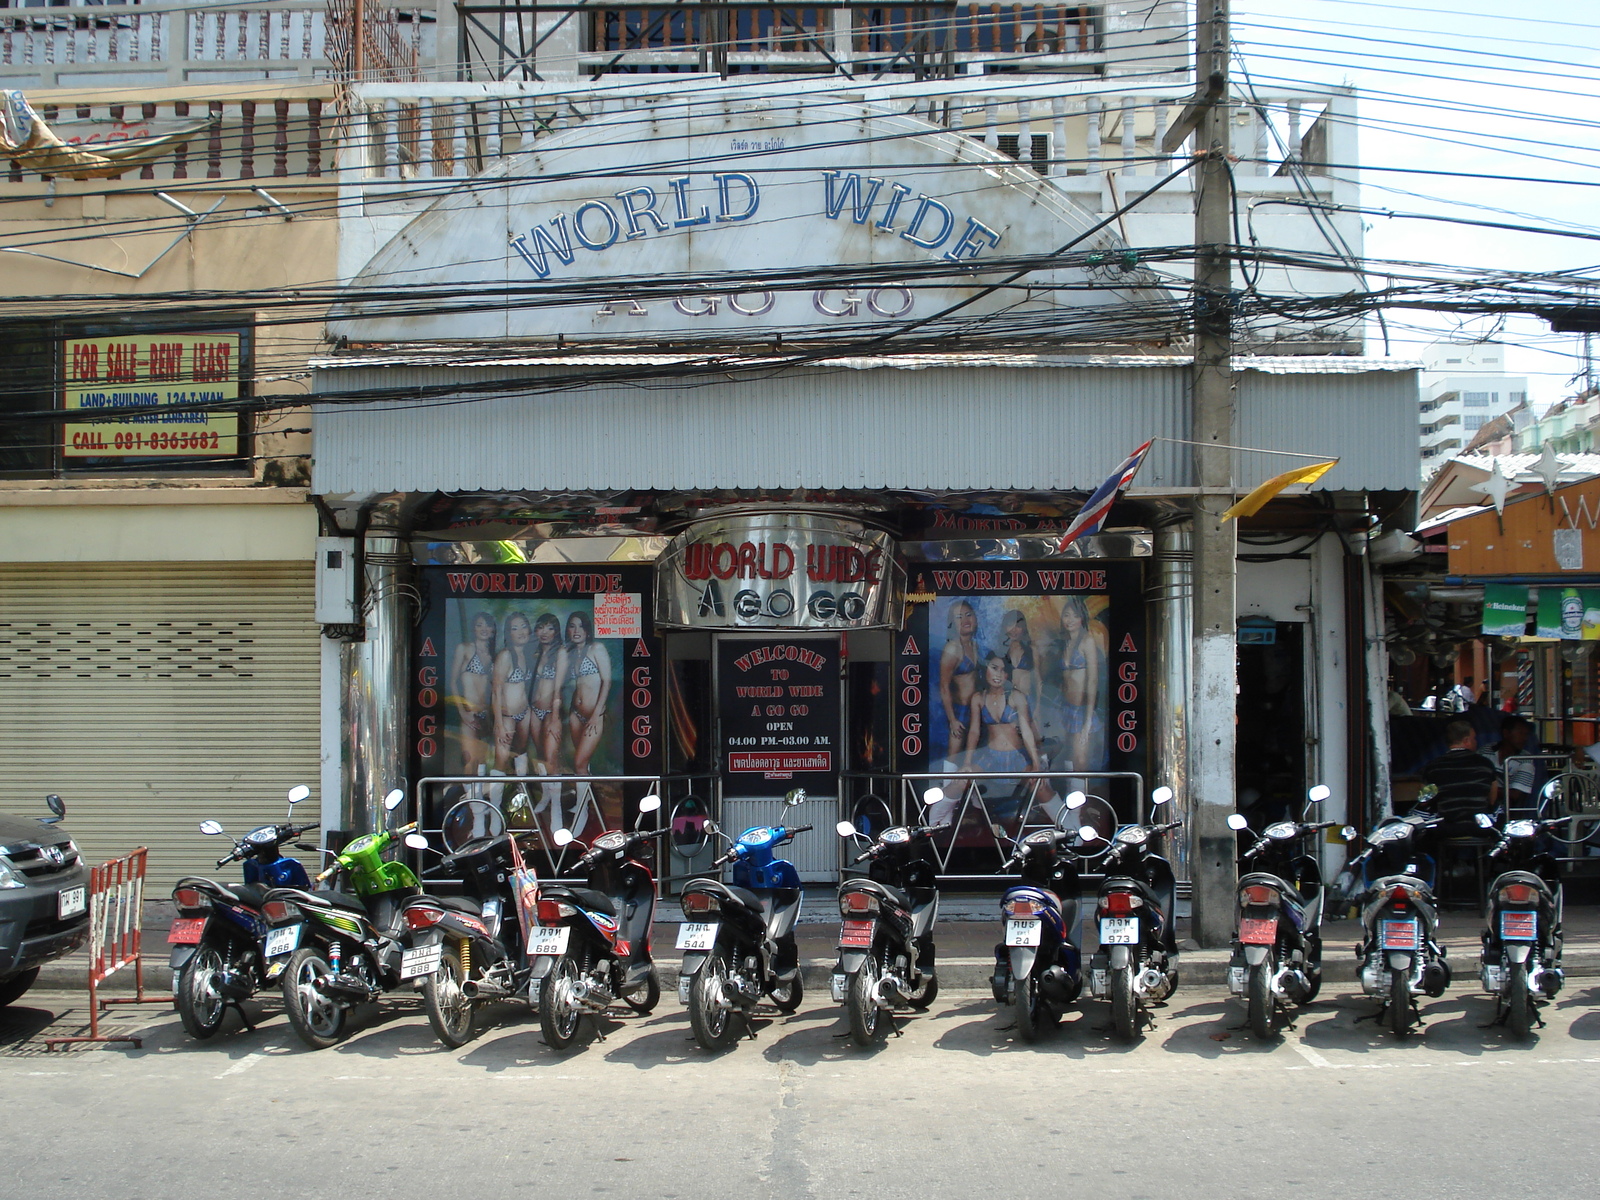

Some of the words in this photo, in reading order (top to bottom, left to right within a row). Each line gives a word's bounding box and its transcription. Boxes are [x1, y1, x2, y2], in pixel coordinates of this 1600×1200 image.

[508, 170, 760, 279] WORLD
[821, 170, 1001, 277] WIDE
[673, 282, 775, 316] GO
[813, 282, 914, 318] GO
[72, 343, 99, 383] FOR
[192, 342, 230, 382] LEAST
[80, 391, 159, 408] LAND+BUILDING
[72, 431, 108, 450] CALL.
[114, 431, 219, 450] 081-8365682
[684, 541, 795, 580] WORLD
[806, 544, 883, 585] WIDE
[447, 572, 544, 593] WORLD
[552, 573, 623, 594] WIDE
[932, 569, 1029, 590] WORLD
[1037, 569, 1107, 590] WIDE
[697, 579, 726, 617] A
[733, 588, 795, 623] GO
[808, 590, 866, 622] GO
[1493, 602, 1526, 612] Heineken
[419, 637, 438, 657] A
[632, 637, 651, 657] A
[902, 635, 920, 655] A
[1118, 632, 1138, 652] A
[734, 645, 826, 672] WELCOME
[770, 669, 790, 681] TO
[736, 686, 783, 698] WORLD
[788, 685, 824, 697] WIDE
[751, 705, 761, 716] A
[766, 704, 785, 716] GO
[790, 704, 809, 716] GO
[766, 722, 794, 731] OPEN
[728, 737, 757, 746] 04.00
[813, 736, 831, 745] AM.
[536, 944, 558, 953] 689
[684, 940, 705, 948] 544
[1015, 937, 1030, 945] 24
[1108, 935, 1130, 943] 973
[271, 943, 290, 955] 266
